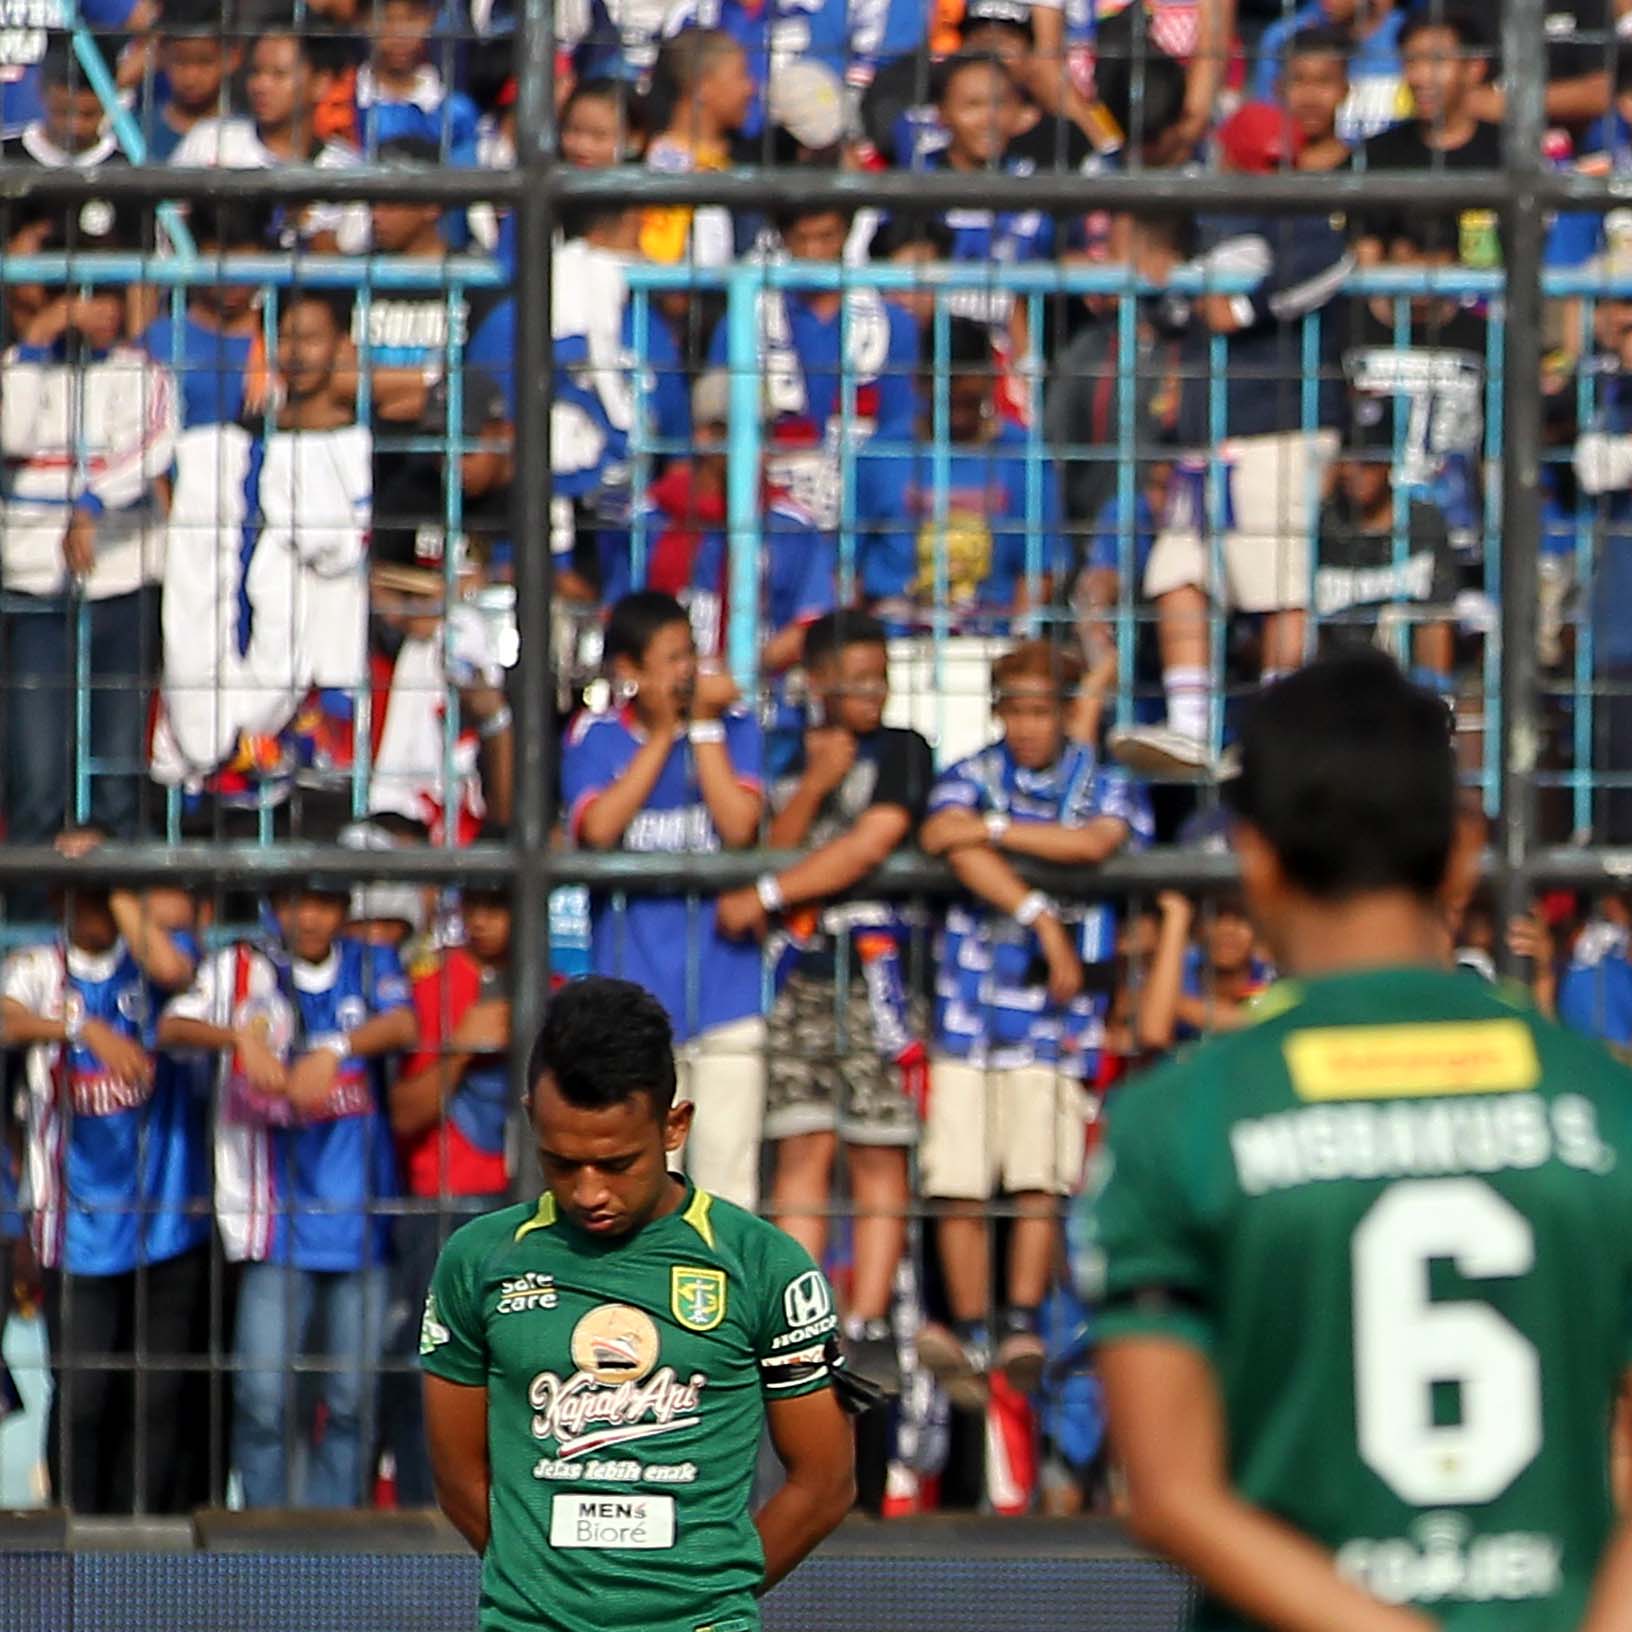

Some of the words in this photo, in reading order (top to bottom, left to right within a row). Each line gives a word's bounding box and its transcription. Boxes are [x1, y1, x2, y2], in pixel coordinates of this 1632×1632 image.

[502, 1272, 554, 1293] safe
[496, 1292, 558, 1314] care
[1351, 1176, 1543, 1507] 6
[529, 1371, 636, 1443] Kapal
[627, 1366, 707, 1425] Api
[642, 1462, 699, 1483] enak
[576, 1519, 647, 1543] Bioré
